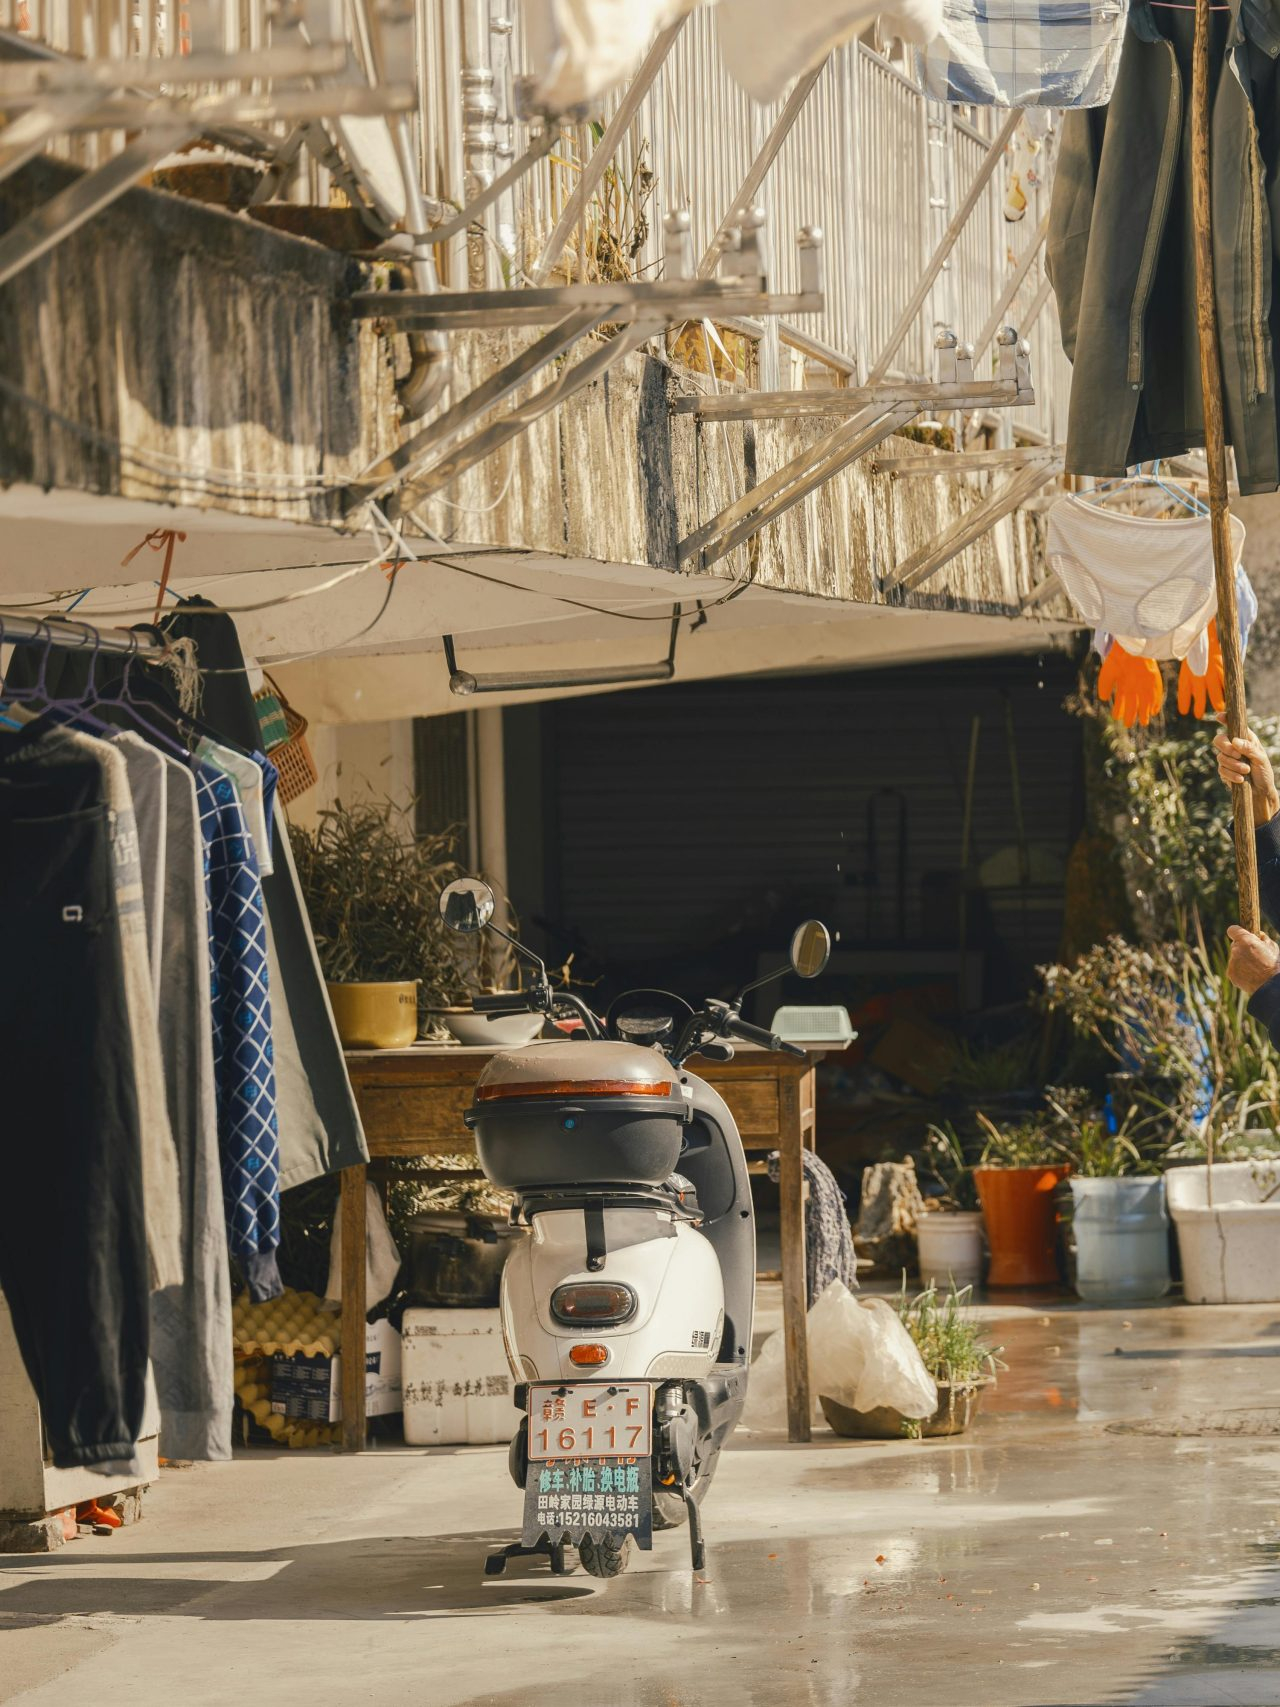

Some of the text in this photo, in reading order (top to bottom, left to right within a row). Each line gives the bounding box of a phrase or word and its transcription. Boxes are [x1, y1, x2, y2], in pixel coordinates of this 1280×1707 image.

[537, 1425, 644, 1452] 16117
[537, 1494, 640, 1512] 田岭家园绿源电动车
